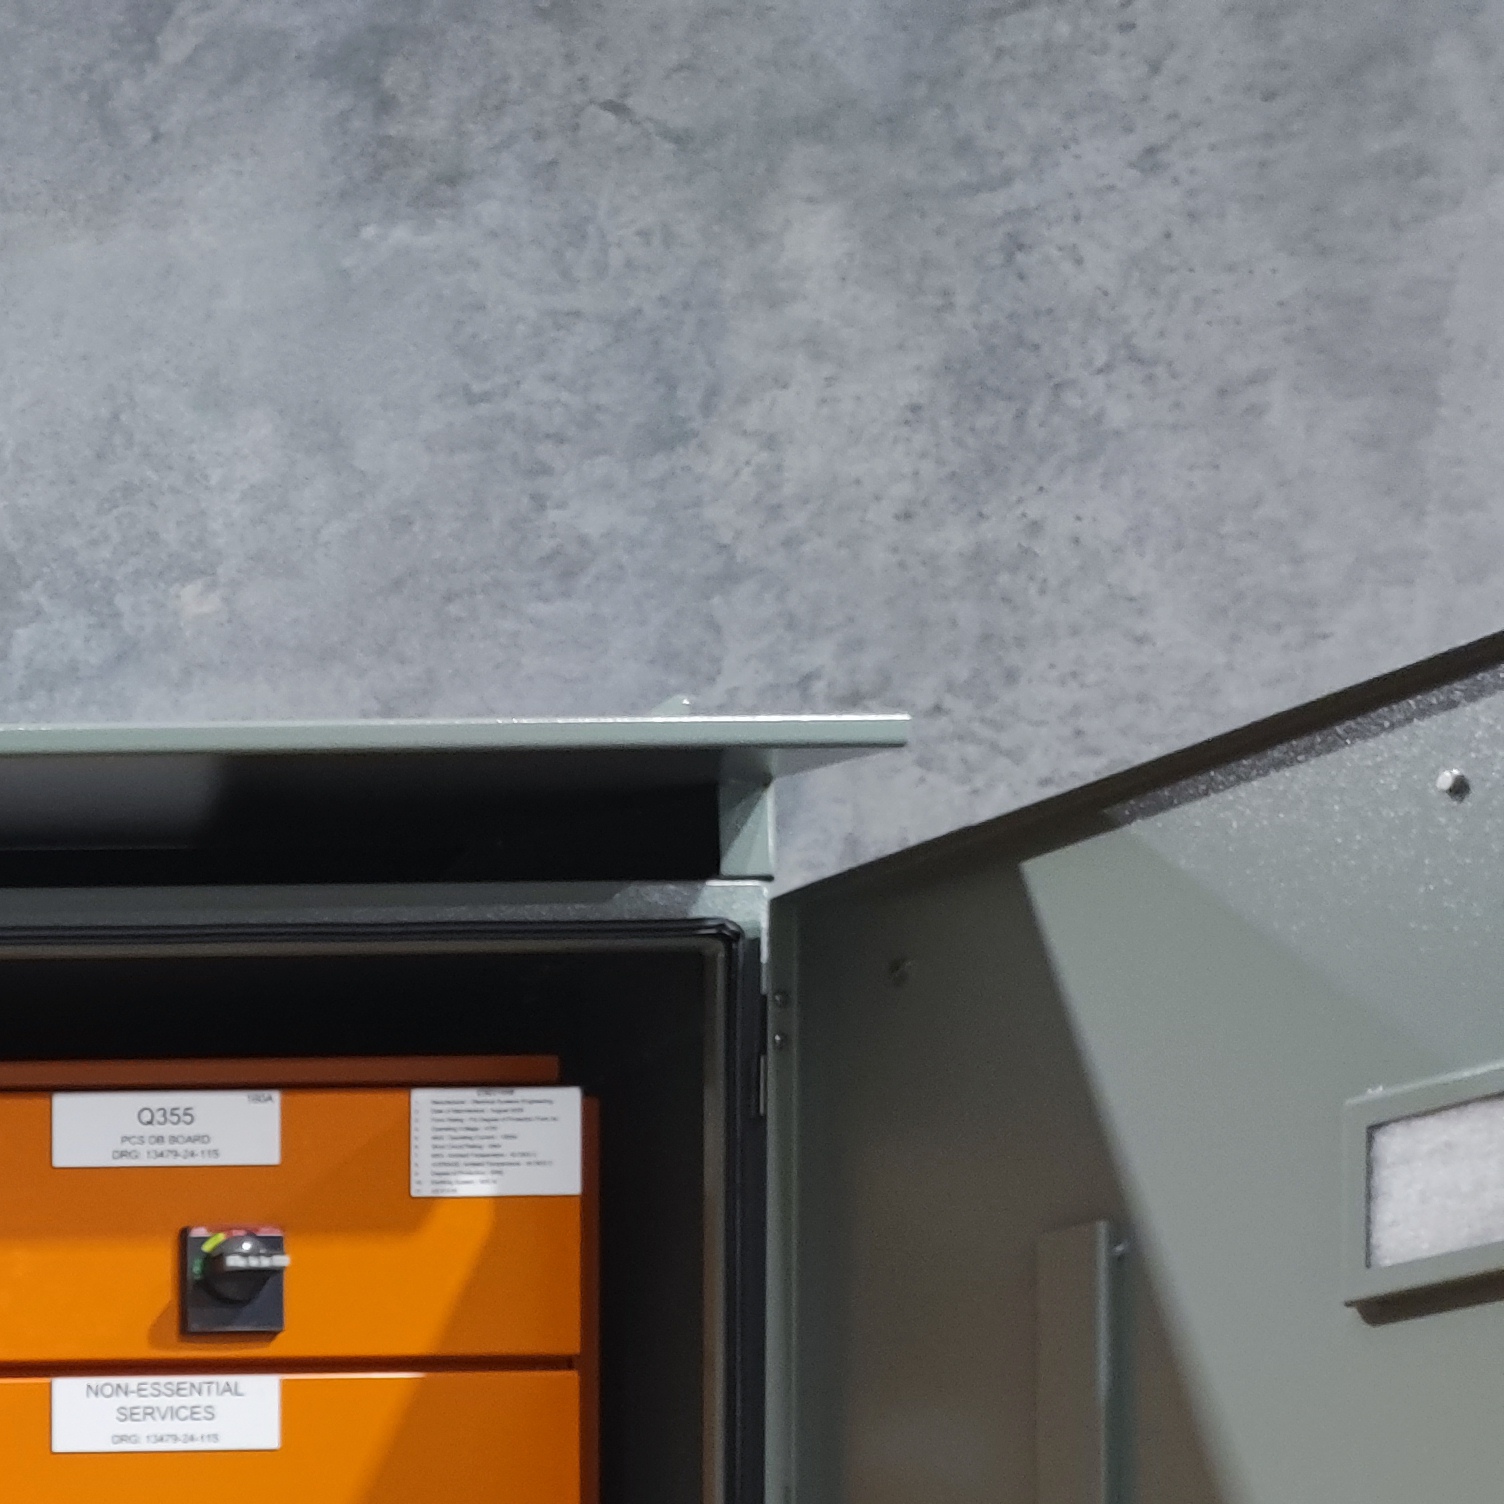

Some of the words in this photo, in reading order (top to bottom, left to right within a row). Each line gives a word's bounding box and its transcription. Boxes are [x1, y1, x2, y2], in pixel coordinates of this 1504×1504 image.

[137, 1107, 195, 1127] Q355
[120, 1135, 145, 1145] PCS
[168, 1135, 211, 1145] BOARD
[85, 1381, 246, 1399] NON-ESSENTIAL
[115, 1405, 216, 1423] SERVICES
